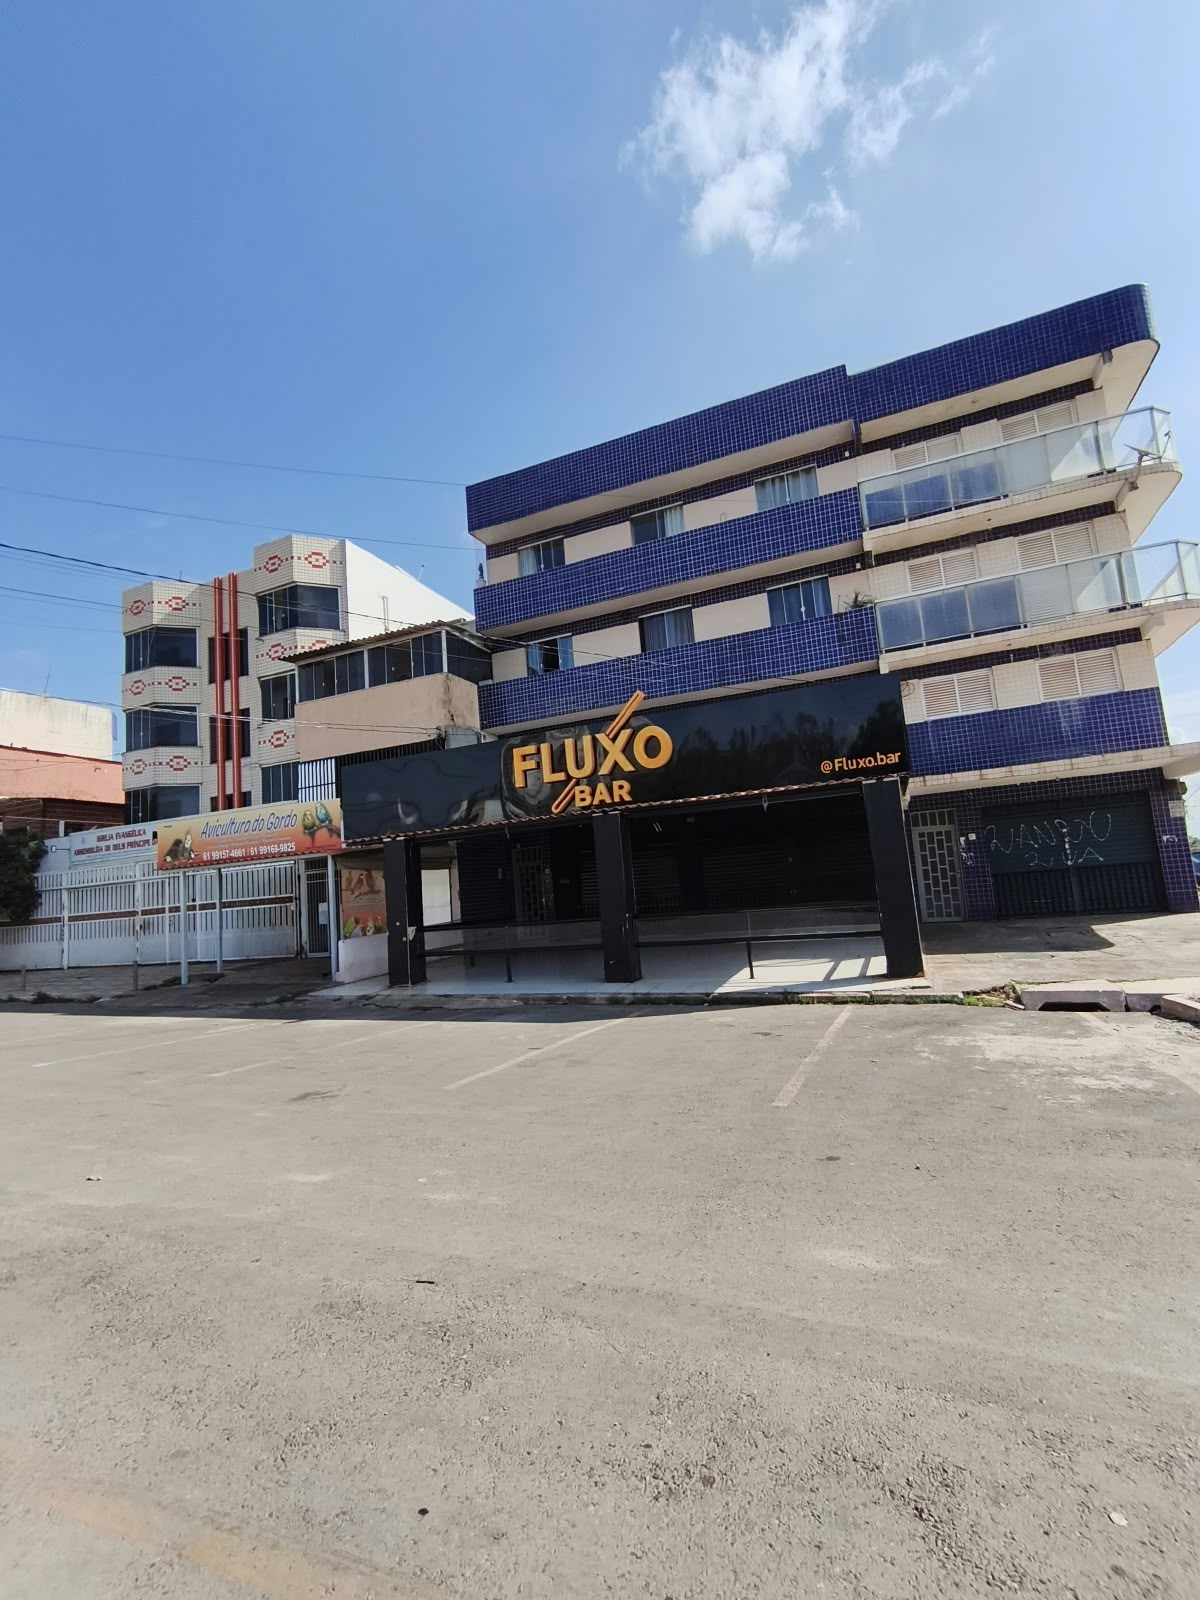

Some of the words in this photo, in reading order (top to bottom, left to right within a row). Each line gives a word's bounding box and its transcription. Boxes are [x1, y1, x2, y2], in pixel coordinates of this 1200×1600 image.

[512, 724, 673, 789] FLUXO
[820, 751, 902, 774] @Fluxo.bar
[573, 779, 633, 808] BAR
[200, 817, 250, 839] Avicultura
[251, 813, 265, 832] do
[266, 808, 298, 831] Gordo
[202, 852, 210, 861] 61
[250, 846, 258, 856] 61
